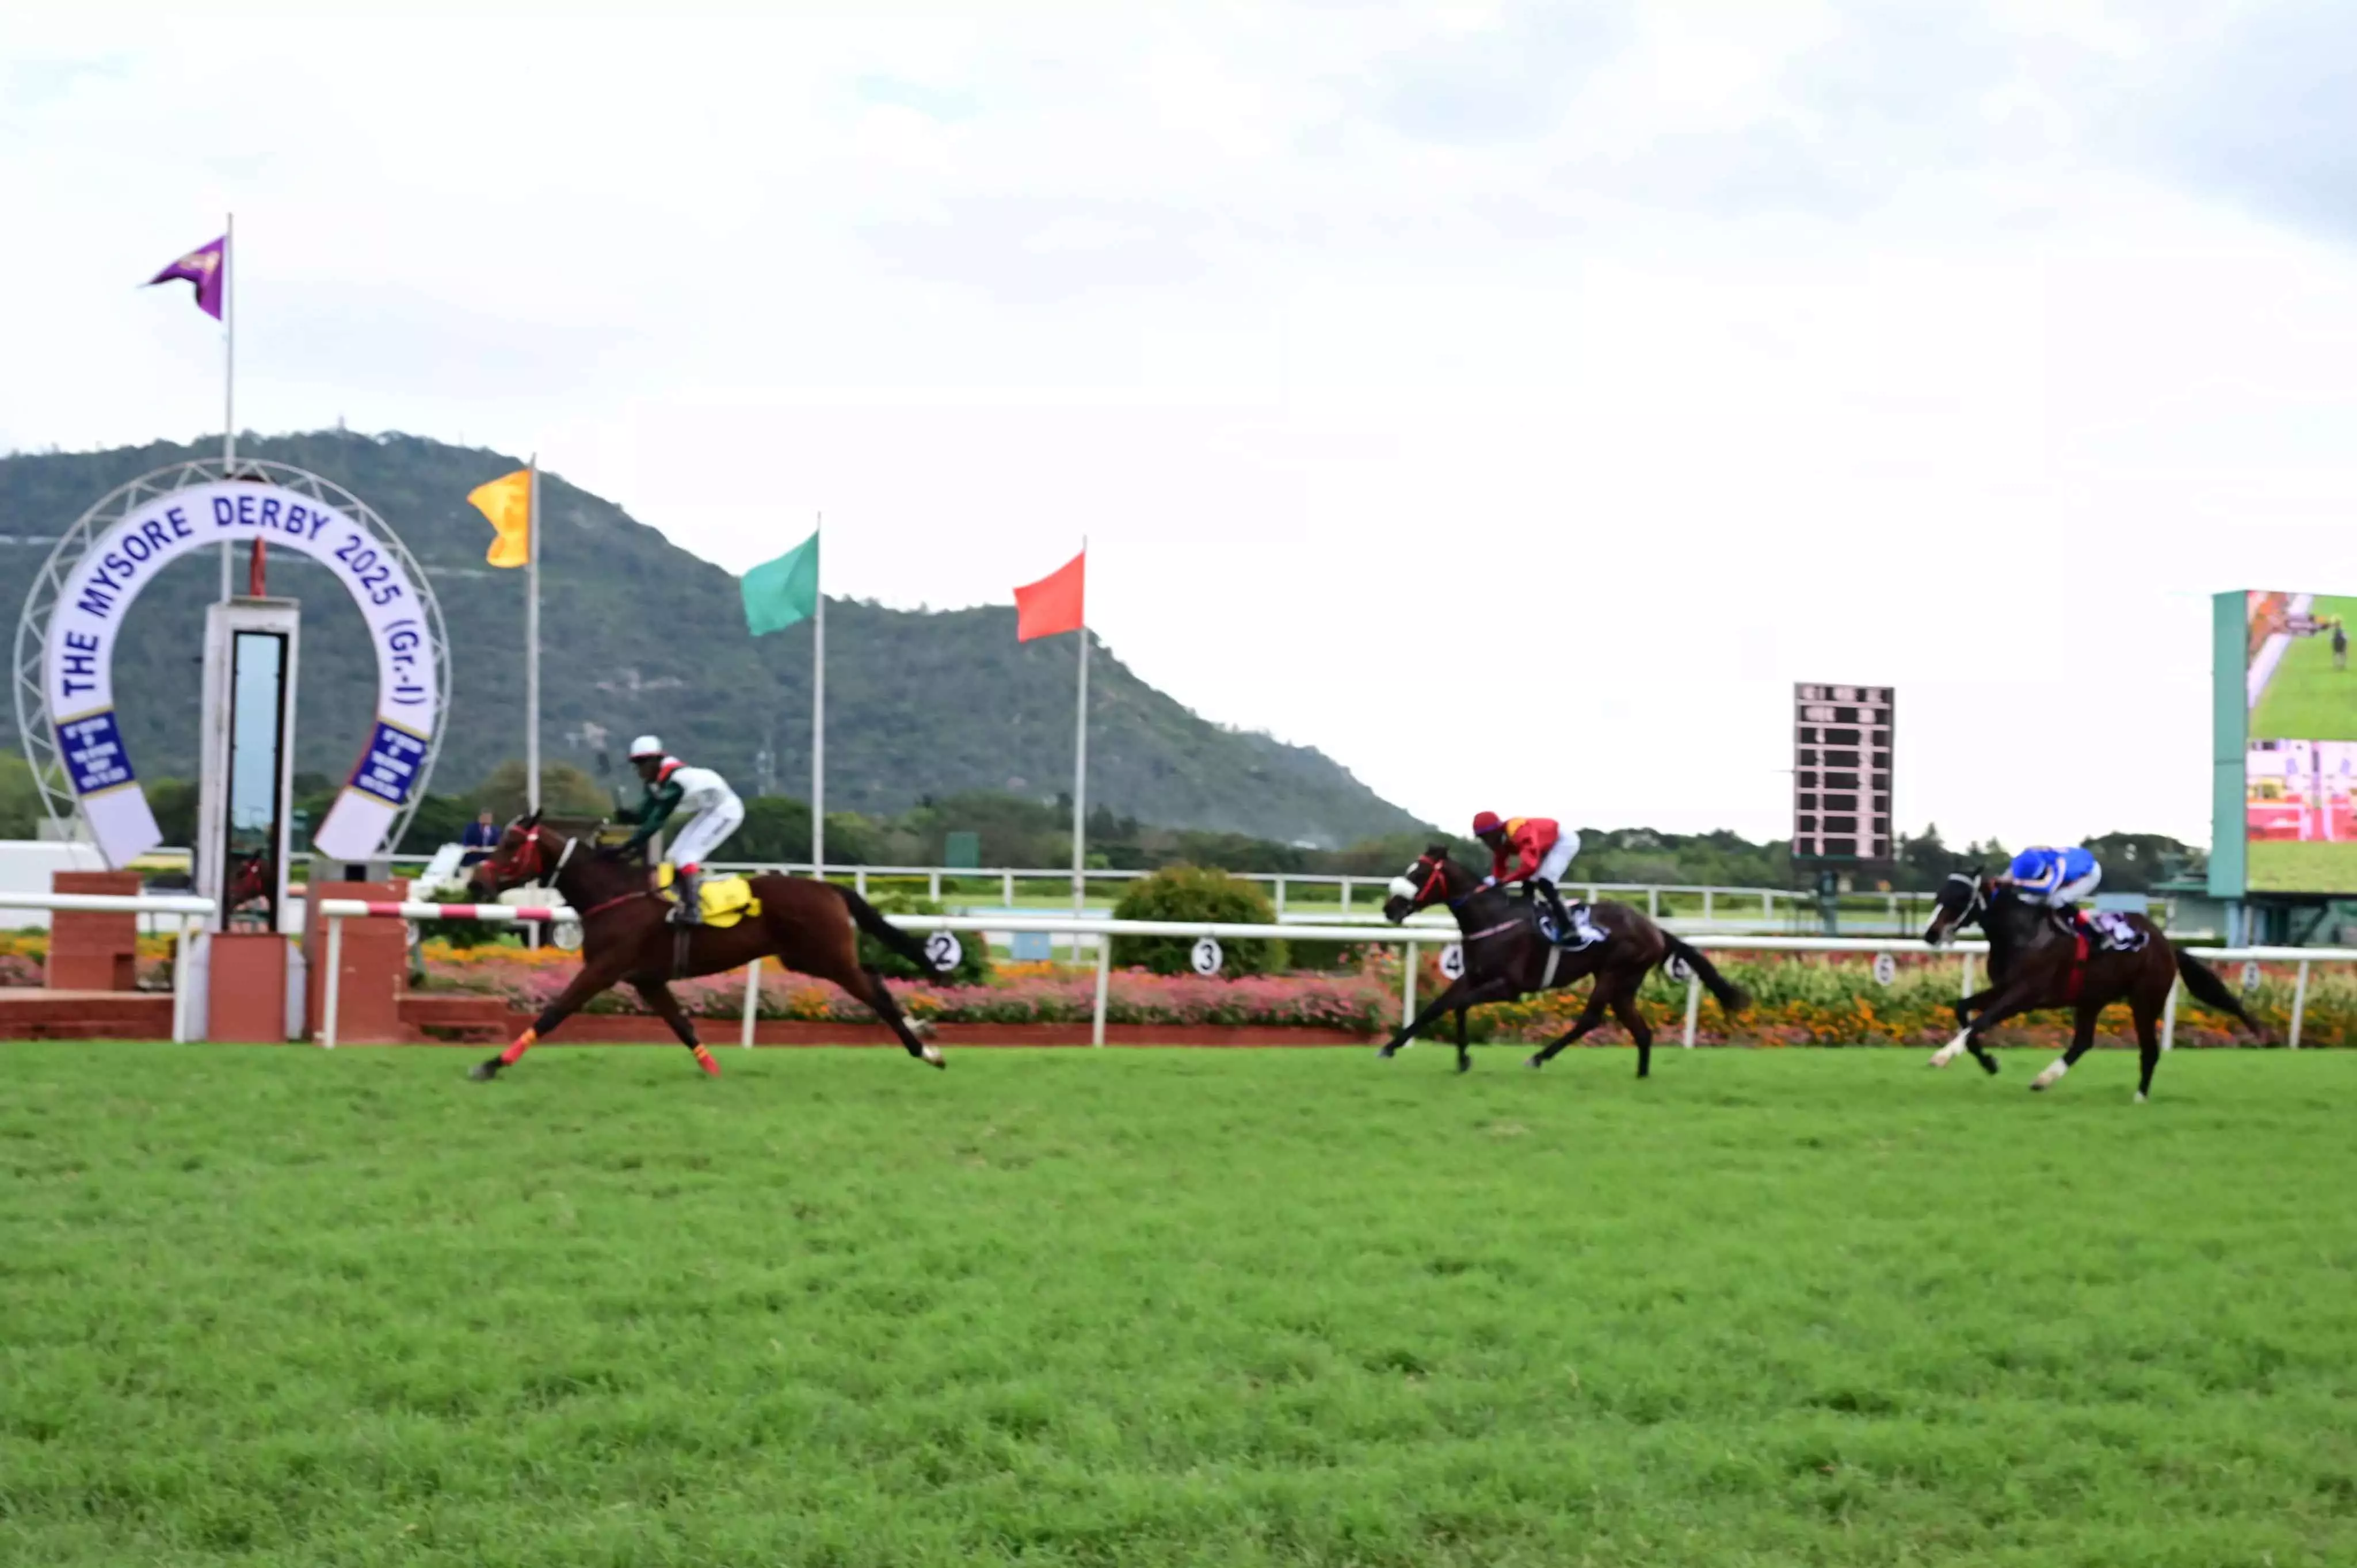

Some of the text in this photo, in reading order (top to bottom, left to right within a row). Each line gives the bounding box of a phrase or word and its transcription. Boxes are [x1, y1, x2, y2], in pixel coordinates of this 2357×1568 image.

[213, 495, 330, 540] DERBY
[78, 508, 194, 618] MYSORE
[335, 536, 402, 606] 2025
[62, 632, 98, 697] THE
[935, 937, 951, 964] 2
[1200, 944, 1214, 970] 3
[1446, 950, 1460, 974] 4
